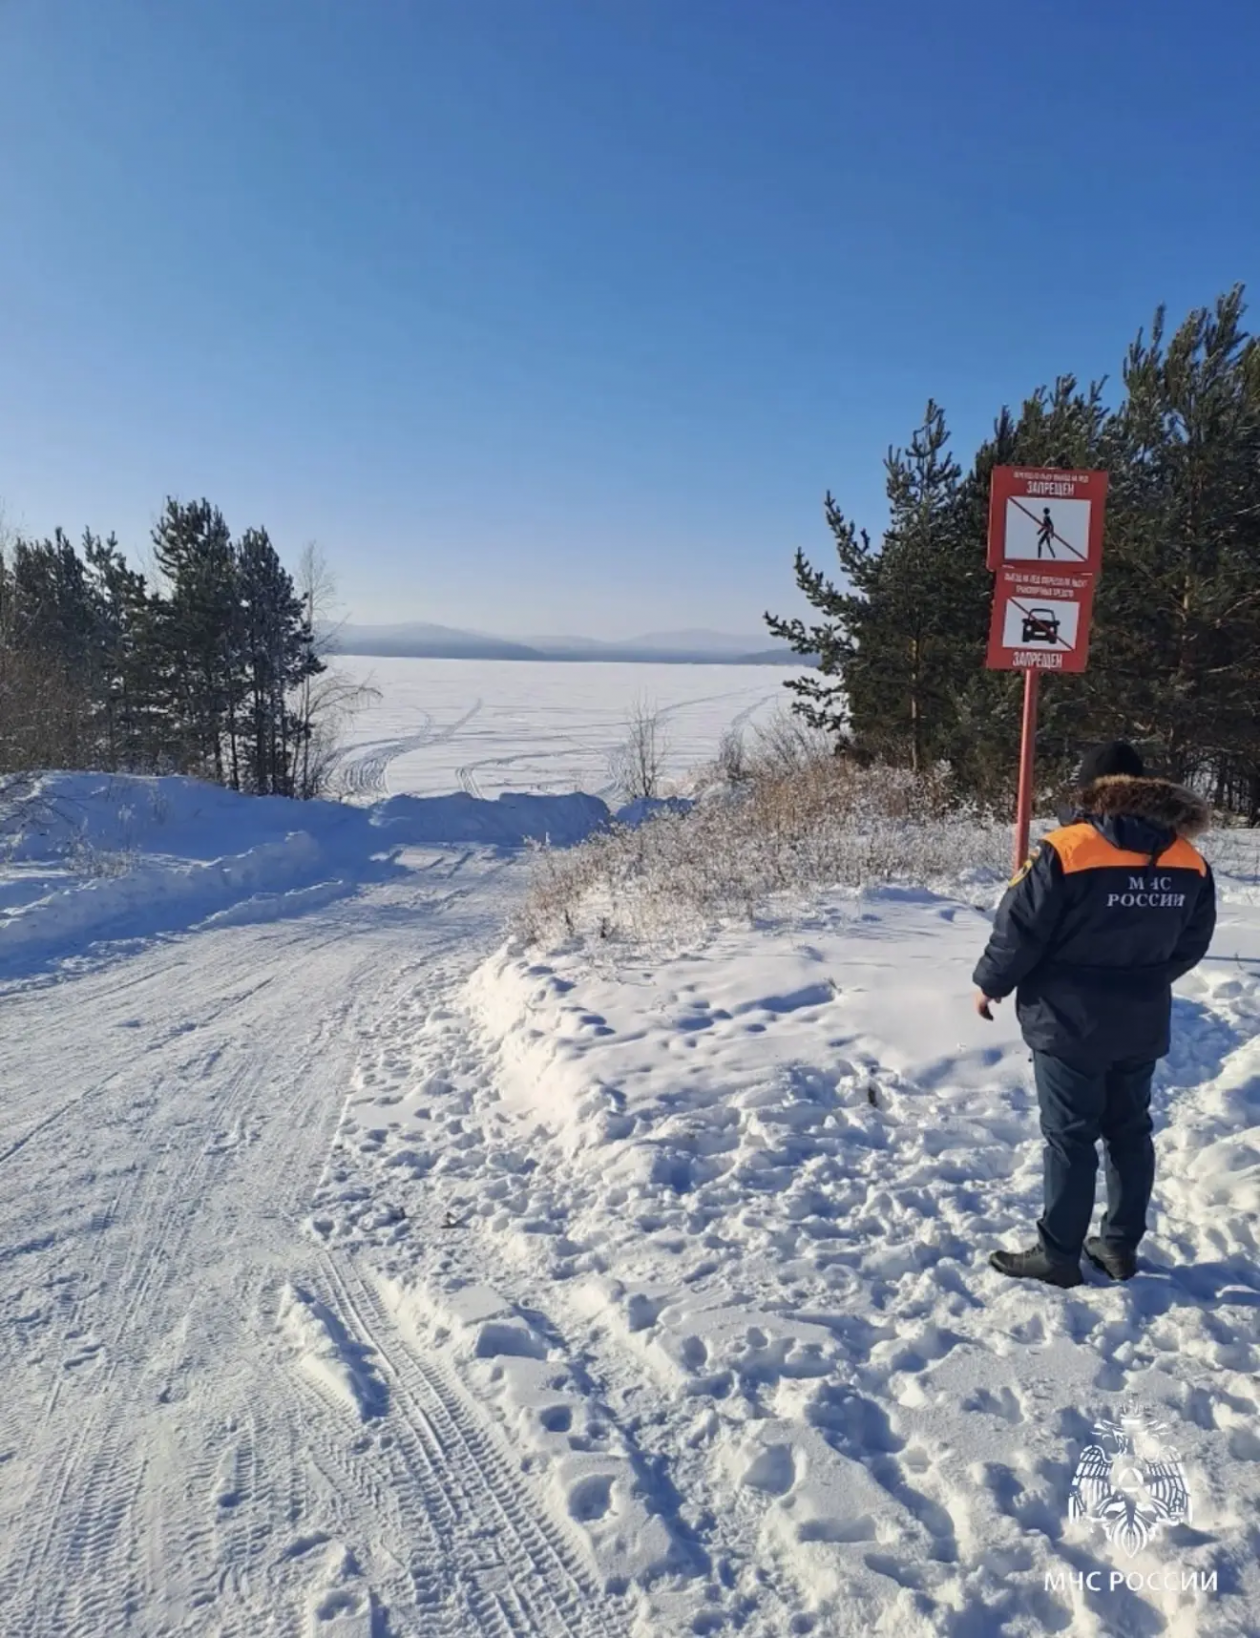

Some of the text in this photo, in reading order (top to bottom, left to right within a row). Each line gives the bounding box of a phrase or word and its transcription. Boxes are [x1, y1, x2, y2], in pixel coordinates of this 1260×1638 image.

[1026, 480, 1075, 496] ЗАПРЕЩЕН
[1012, 651, 1063, 669] ЗАПРЕЩЕН
[1106, 893, 1186, 908] РОССИИ
